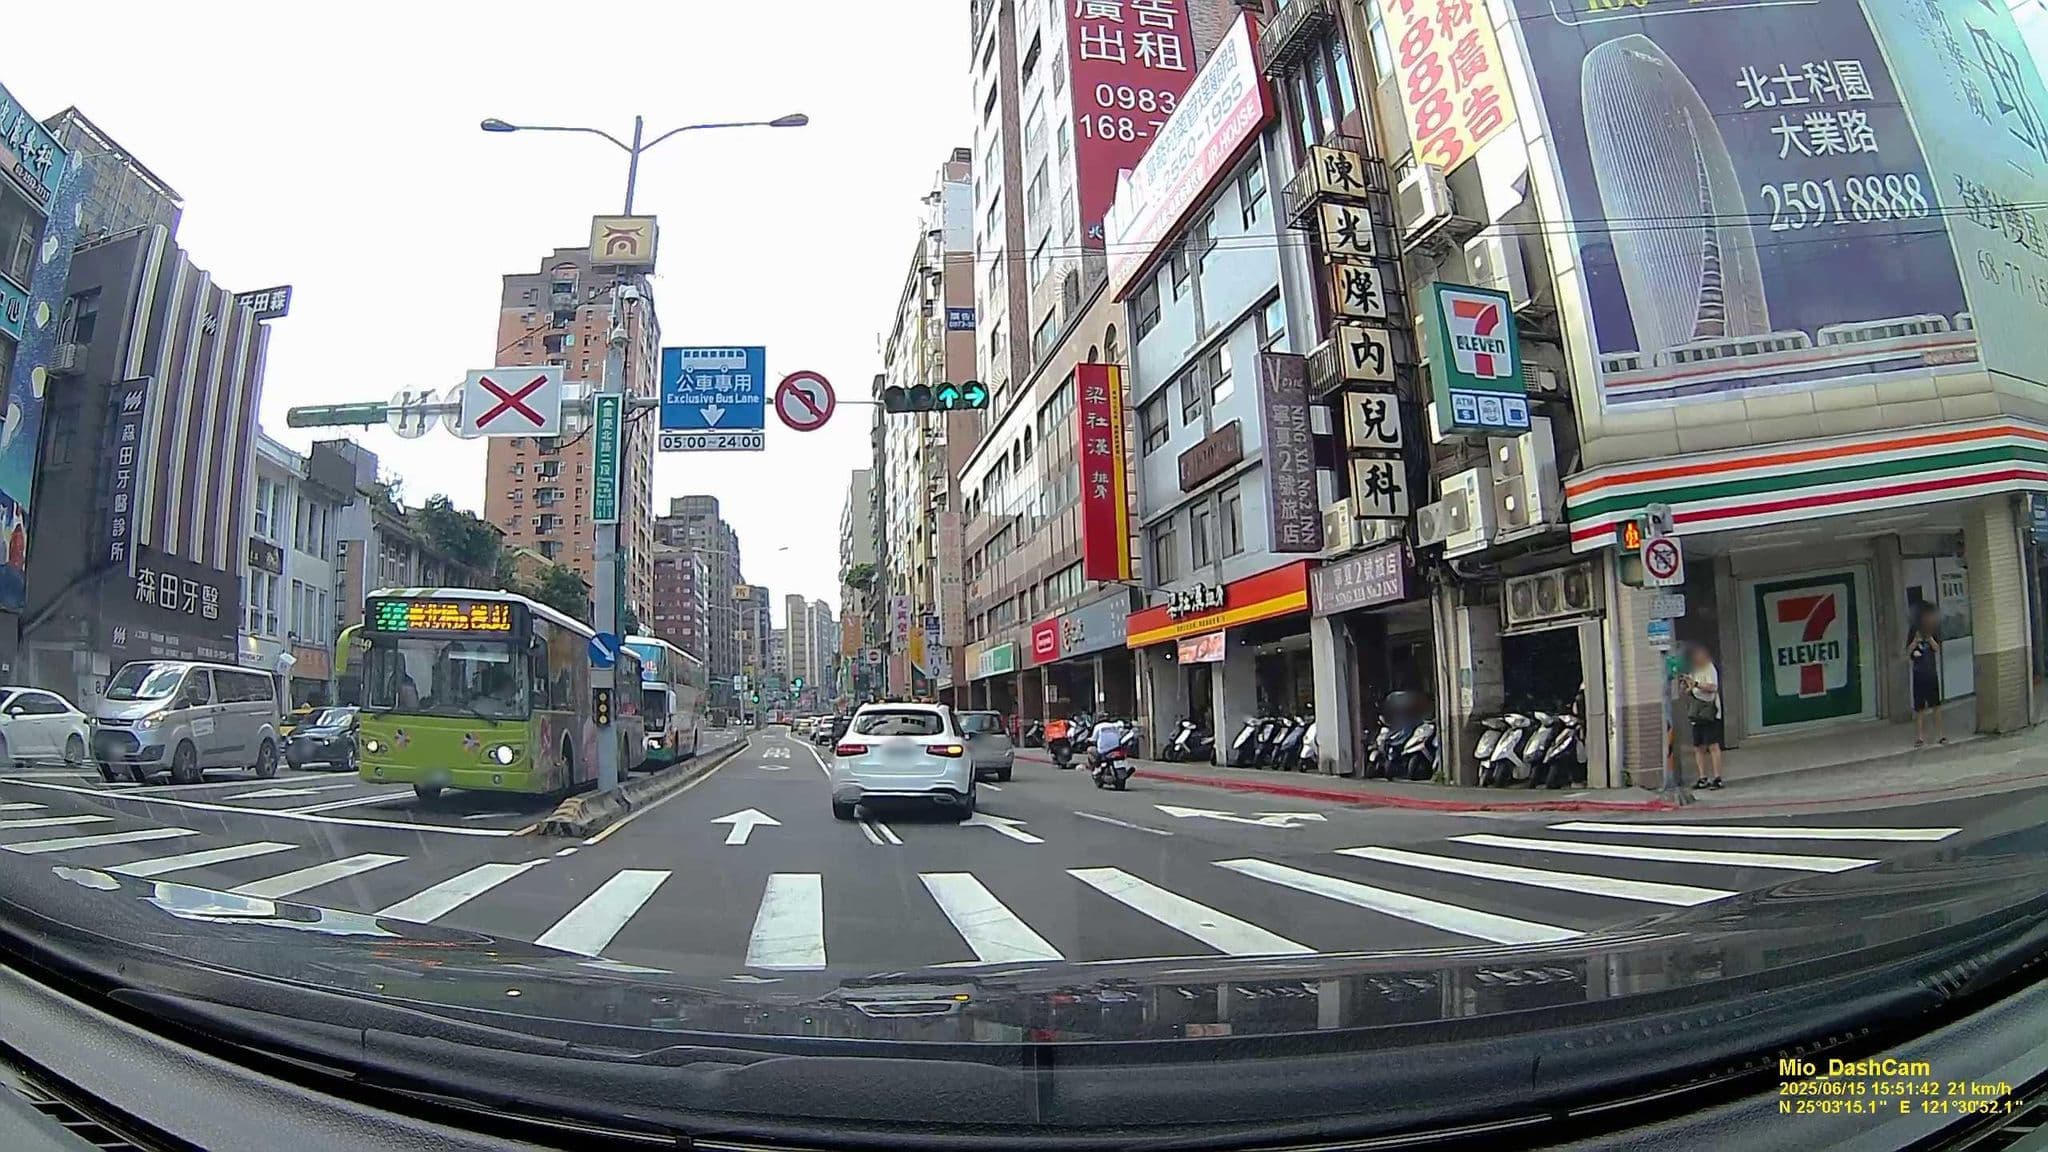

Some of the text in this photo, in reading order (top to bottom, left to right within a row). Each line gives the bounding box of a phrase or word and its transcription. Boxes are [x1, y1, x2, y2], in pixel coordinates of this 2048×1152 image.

[1080, 25, 1187, 71] 出租
[1095, 83, 1176, 115] 0983
[1736, 60, 1874, 109] 北士科園
[1771, 110, 1879, 159] 大業路
[667, 393, 760, 404] Exclusive Bus Lane
[676, 374, 751, 392] 公車專用
[110, 424, 137, 562] 森田牙醫診所
[1301, 515, 1316, 545] INN
[135, 568, 219, 620] 森田牙醫
